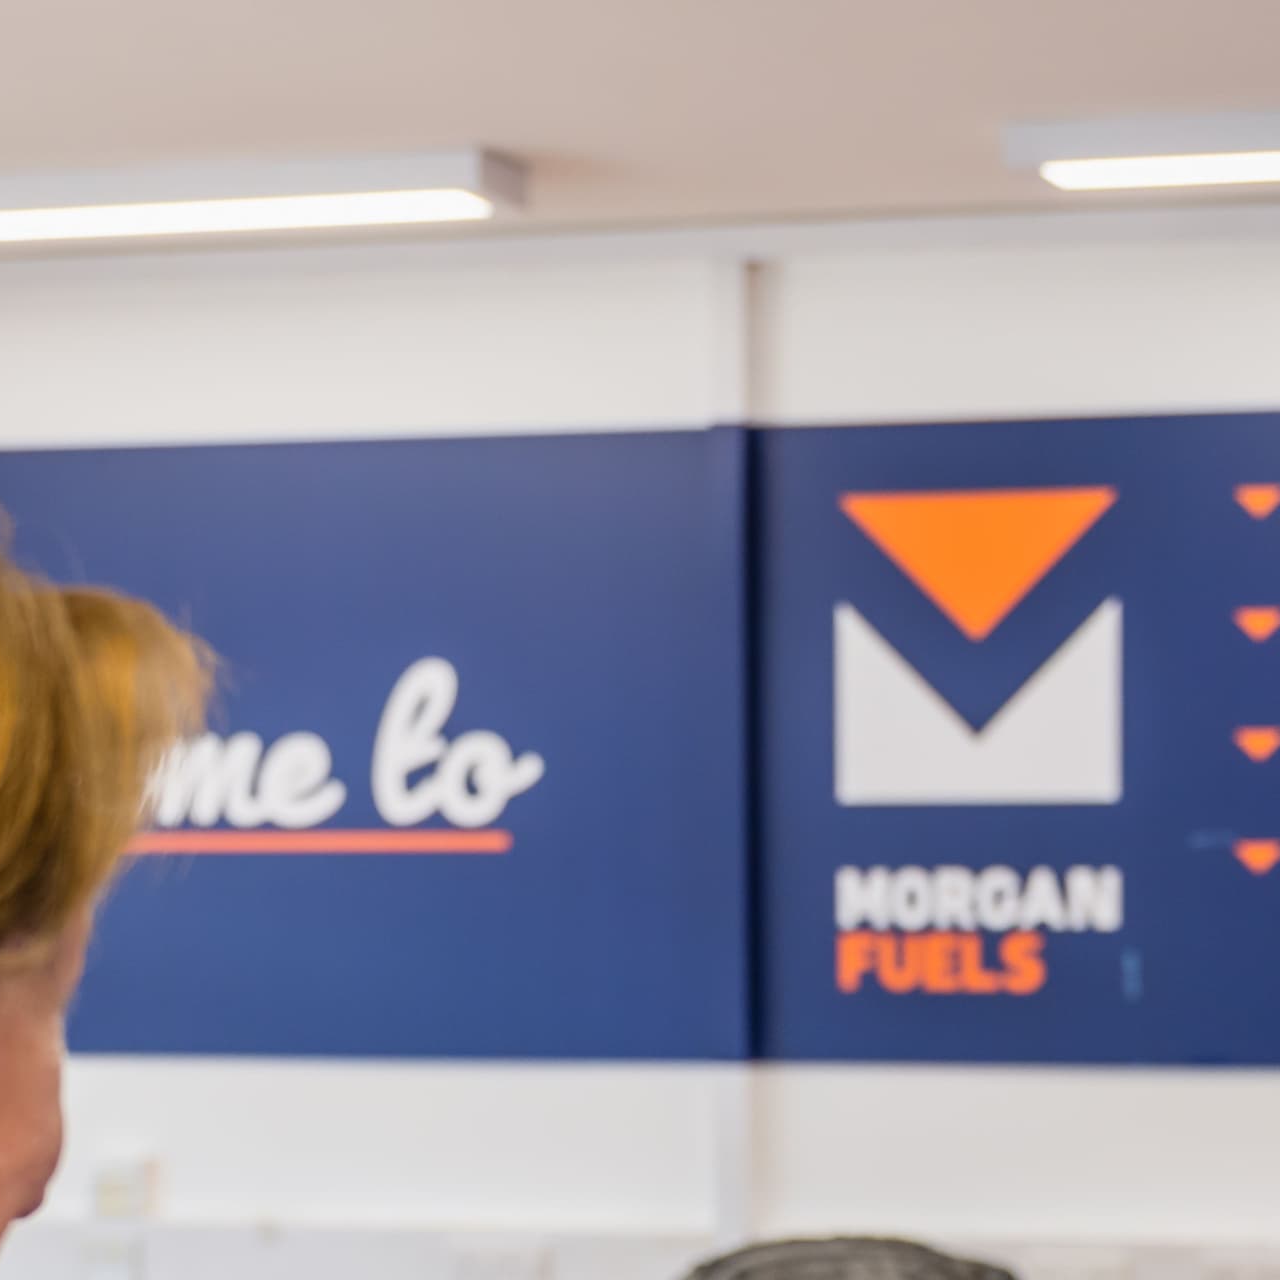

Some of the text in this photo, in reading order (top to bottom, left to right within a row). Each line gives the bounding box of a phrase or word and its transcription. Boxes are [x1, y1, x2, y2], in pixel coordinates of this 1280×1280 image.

[136, 655, 545, 830] me to
[835, 866, 1122, 931] MORGAN
[835, 931, 1047, 994] FUELS
